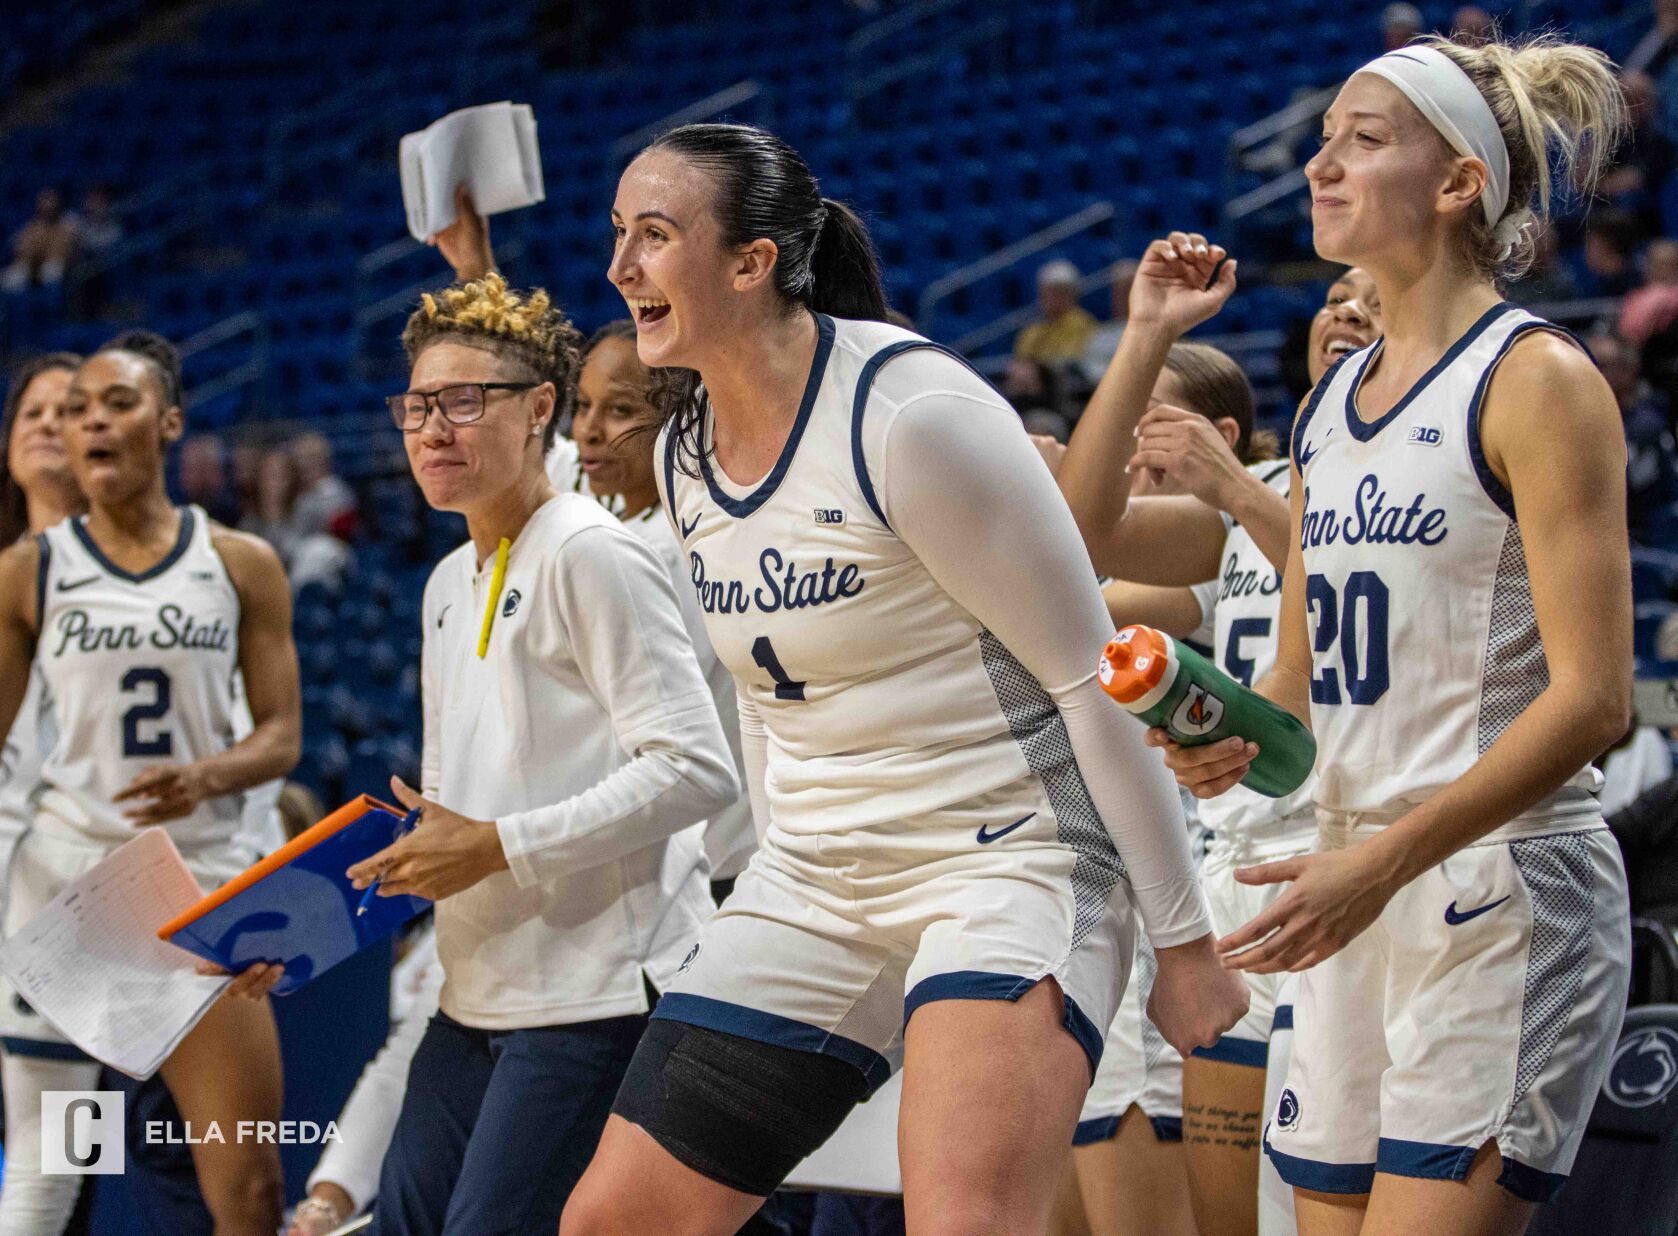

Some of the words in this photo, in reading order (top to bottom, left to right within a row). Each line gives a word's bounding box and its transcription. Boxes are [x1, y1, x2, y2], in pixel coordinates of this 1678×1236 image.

[1342, 473, 1448, 546] State
[690, 551, 750, 614] Penn
[754, 547, 865, 614] State
[54, 609, 144, 658] Penn
[1225, 617, 1272, 690] 5
[1306, 570, 1390, 705] 20
[751, 636, 807, 702] 1
[121, 667, 173, 757] 2
[1171, 681, 1226, 736] G
